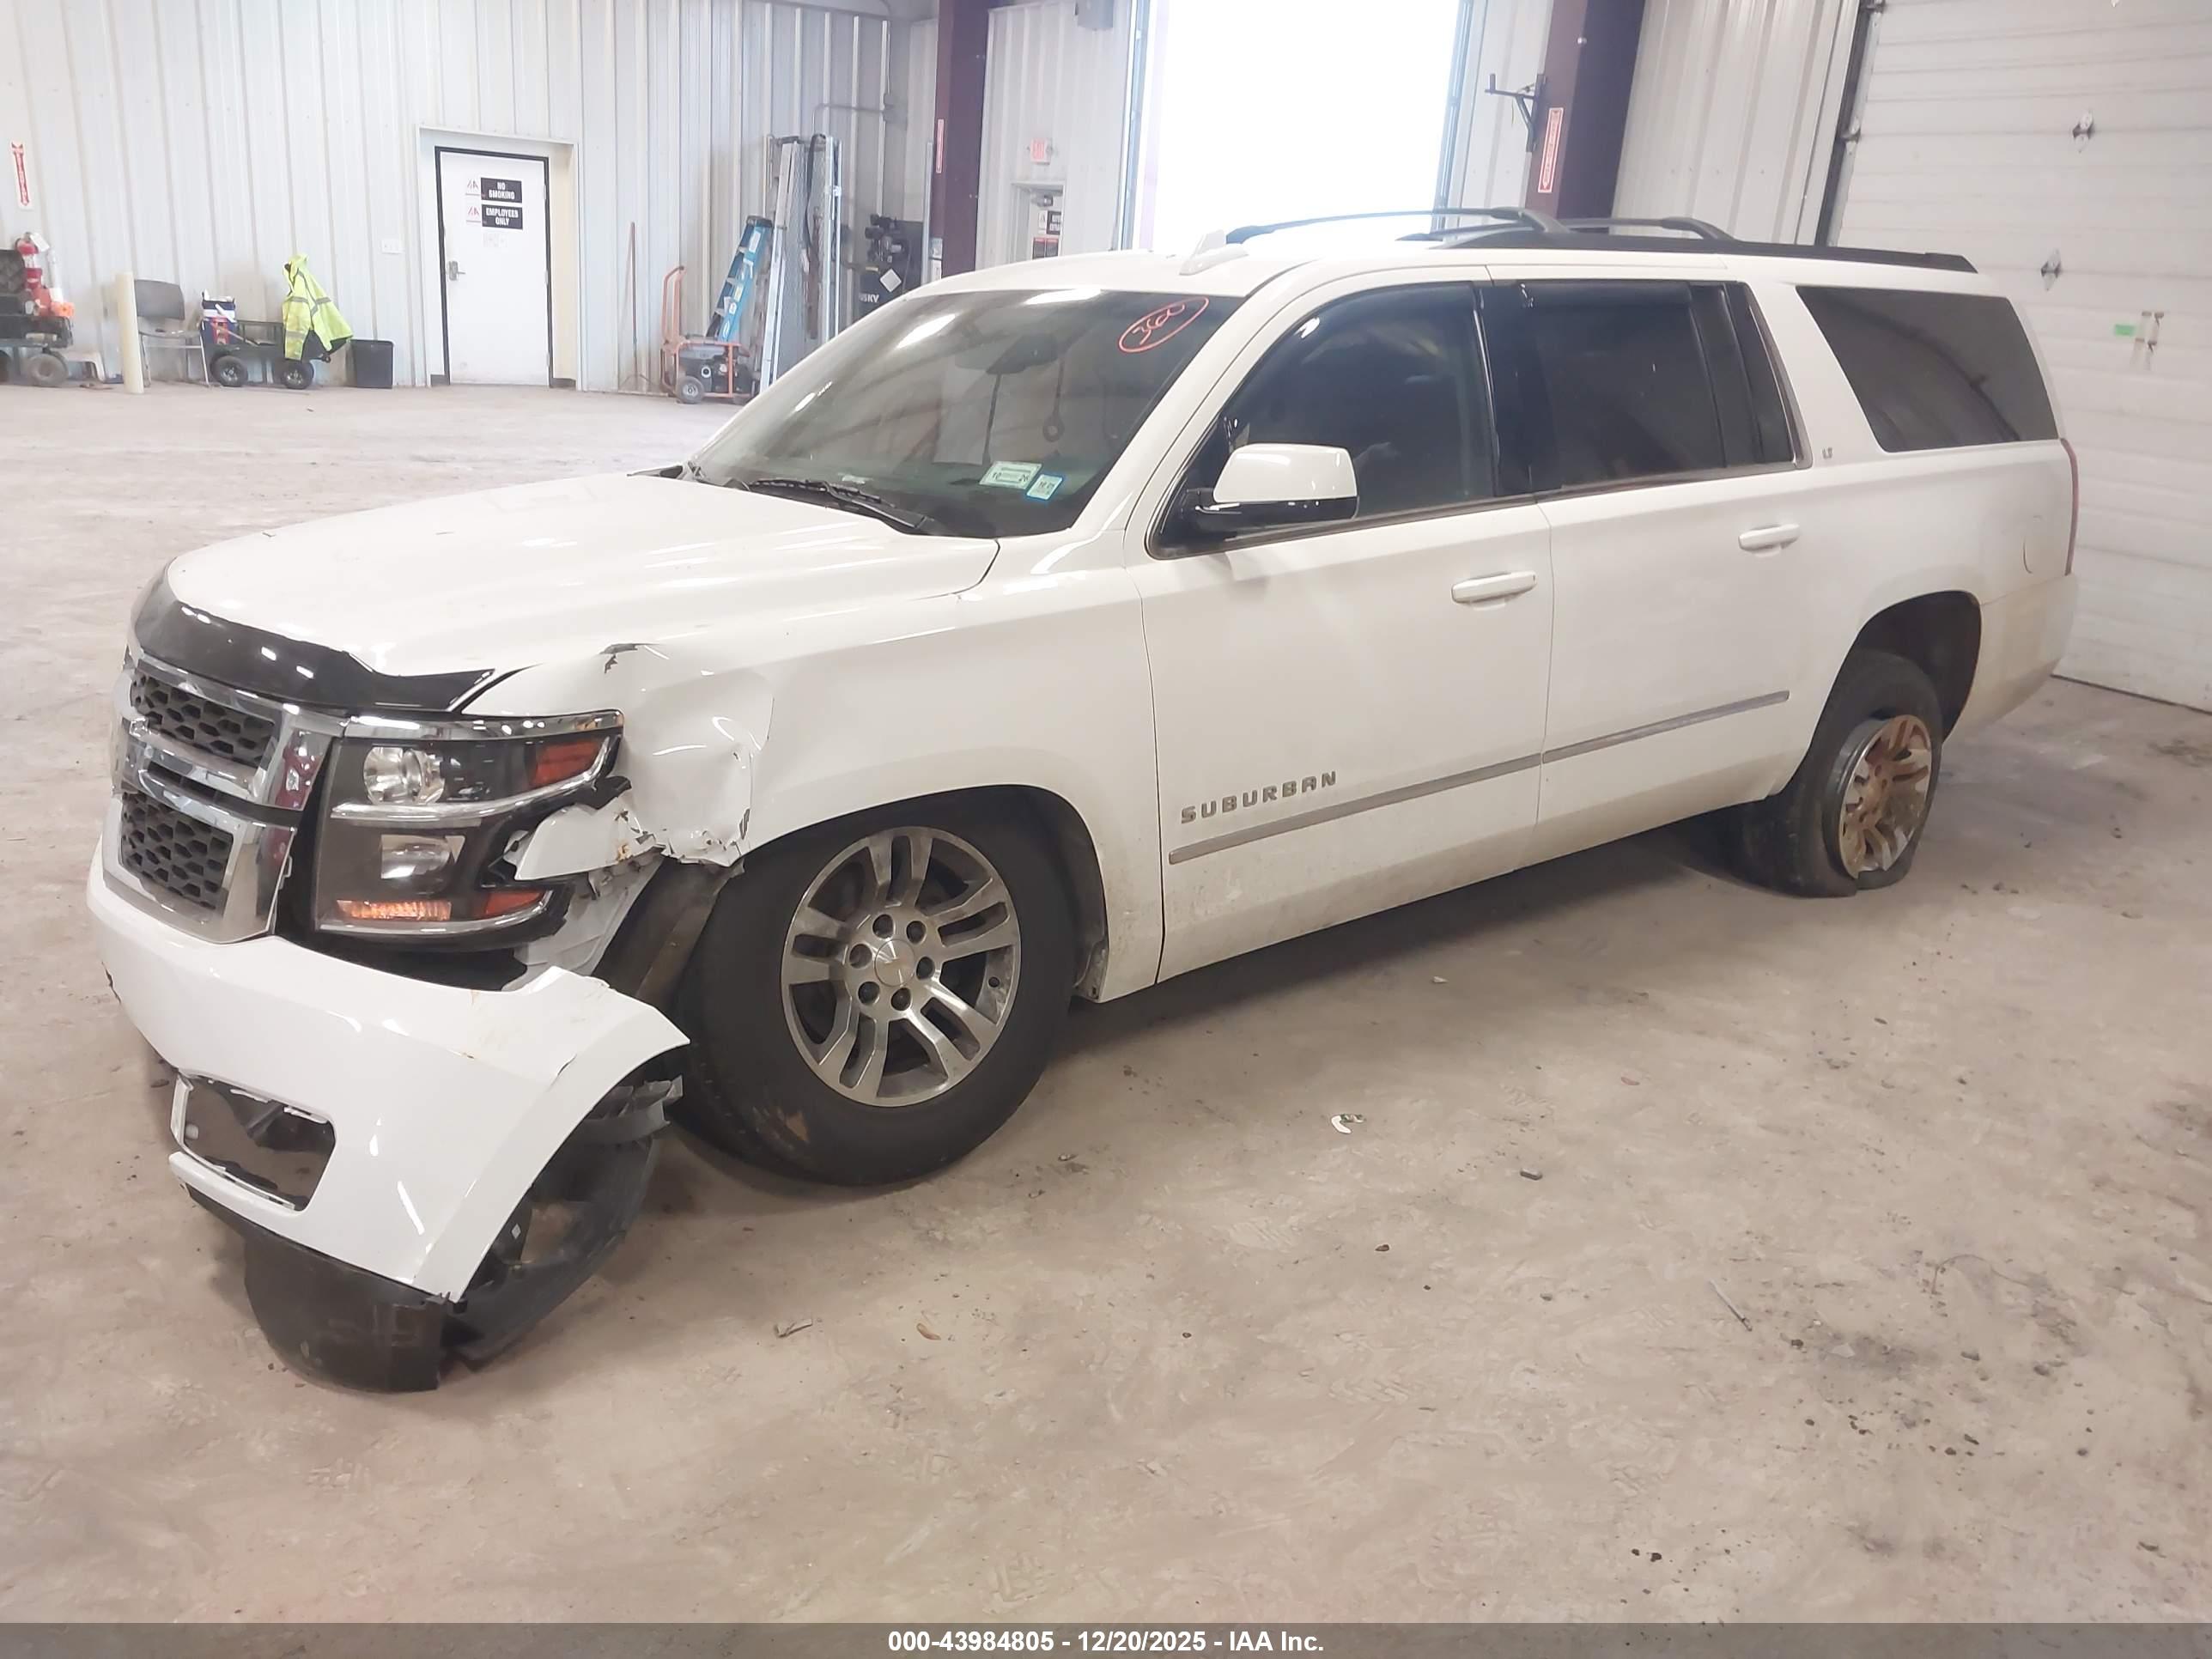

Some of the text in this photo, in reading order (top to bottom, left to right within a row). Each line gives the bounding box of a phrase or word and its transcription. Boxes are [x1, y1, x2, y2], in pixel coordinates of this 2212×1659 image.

[497, 181, 506, 190] NO
[489, 189, 515, 199] SMOKING
[485, 207, 519, 218] EMPLOYEES
[495, 216, 509, 226] ONLY
[1182, 771, 1336, 824] SUBURBAN
